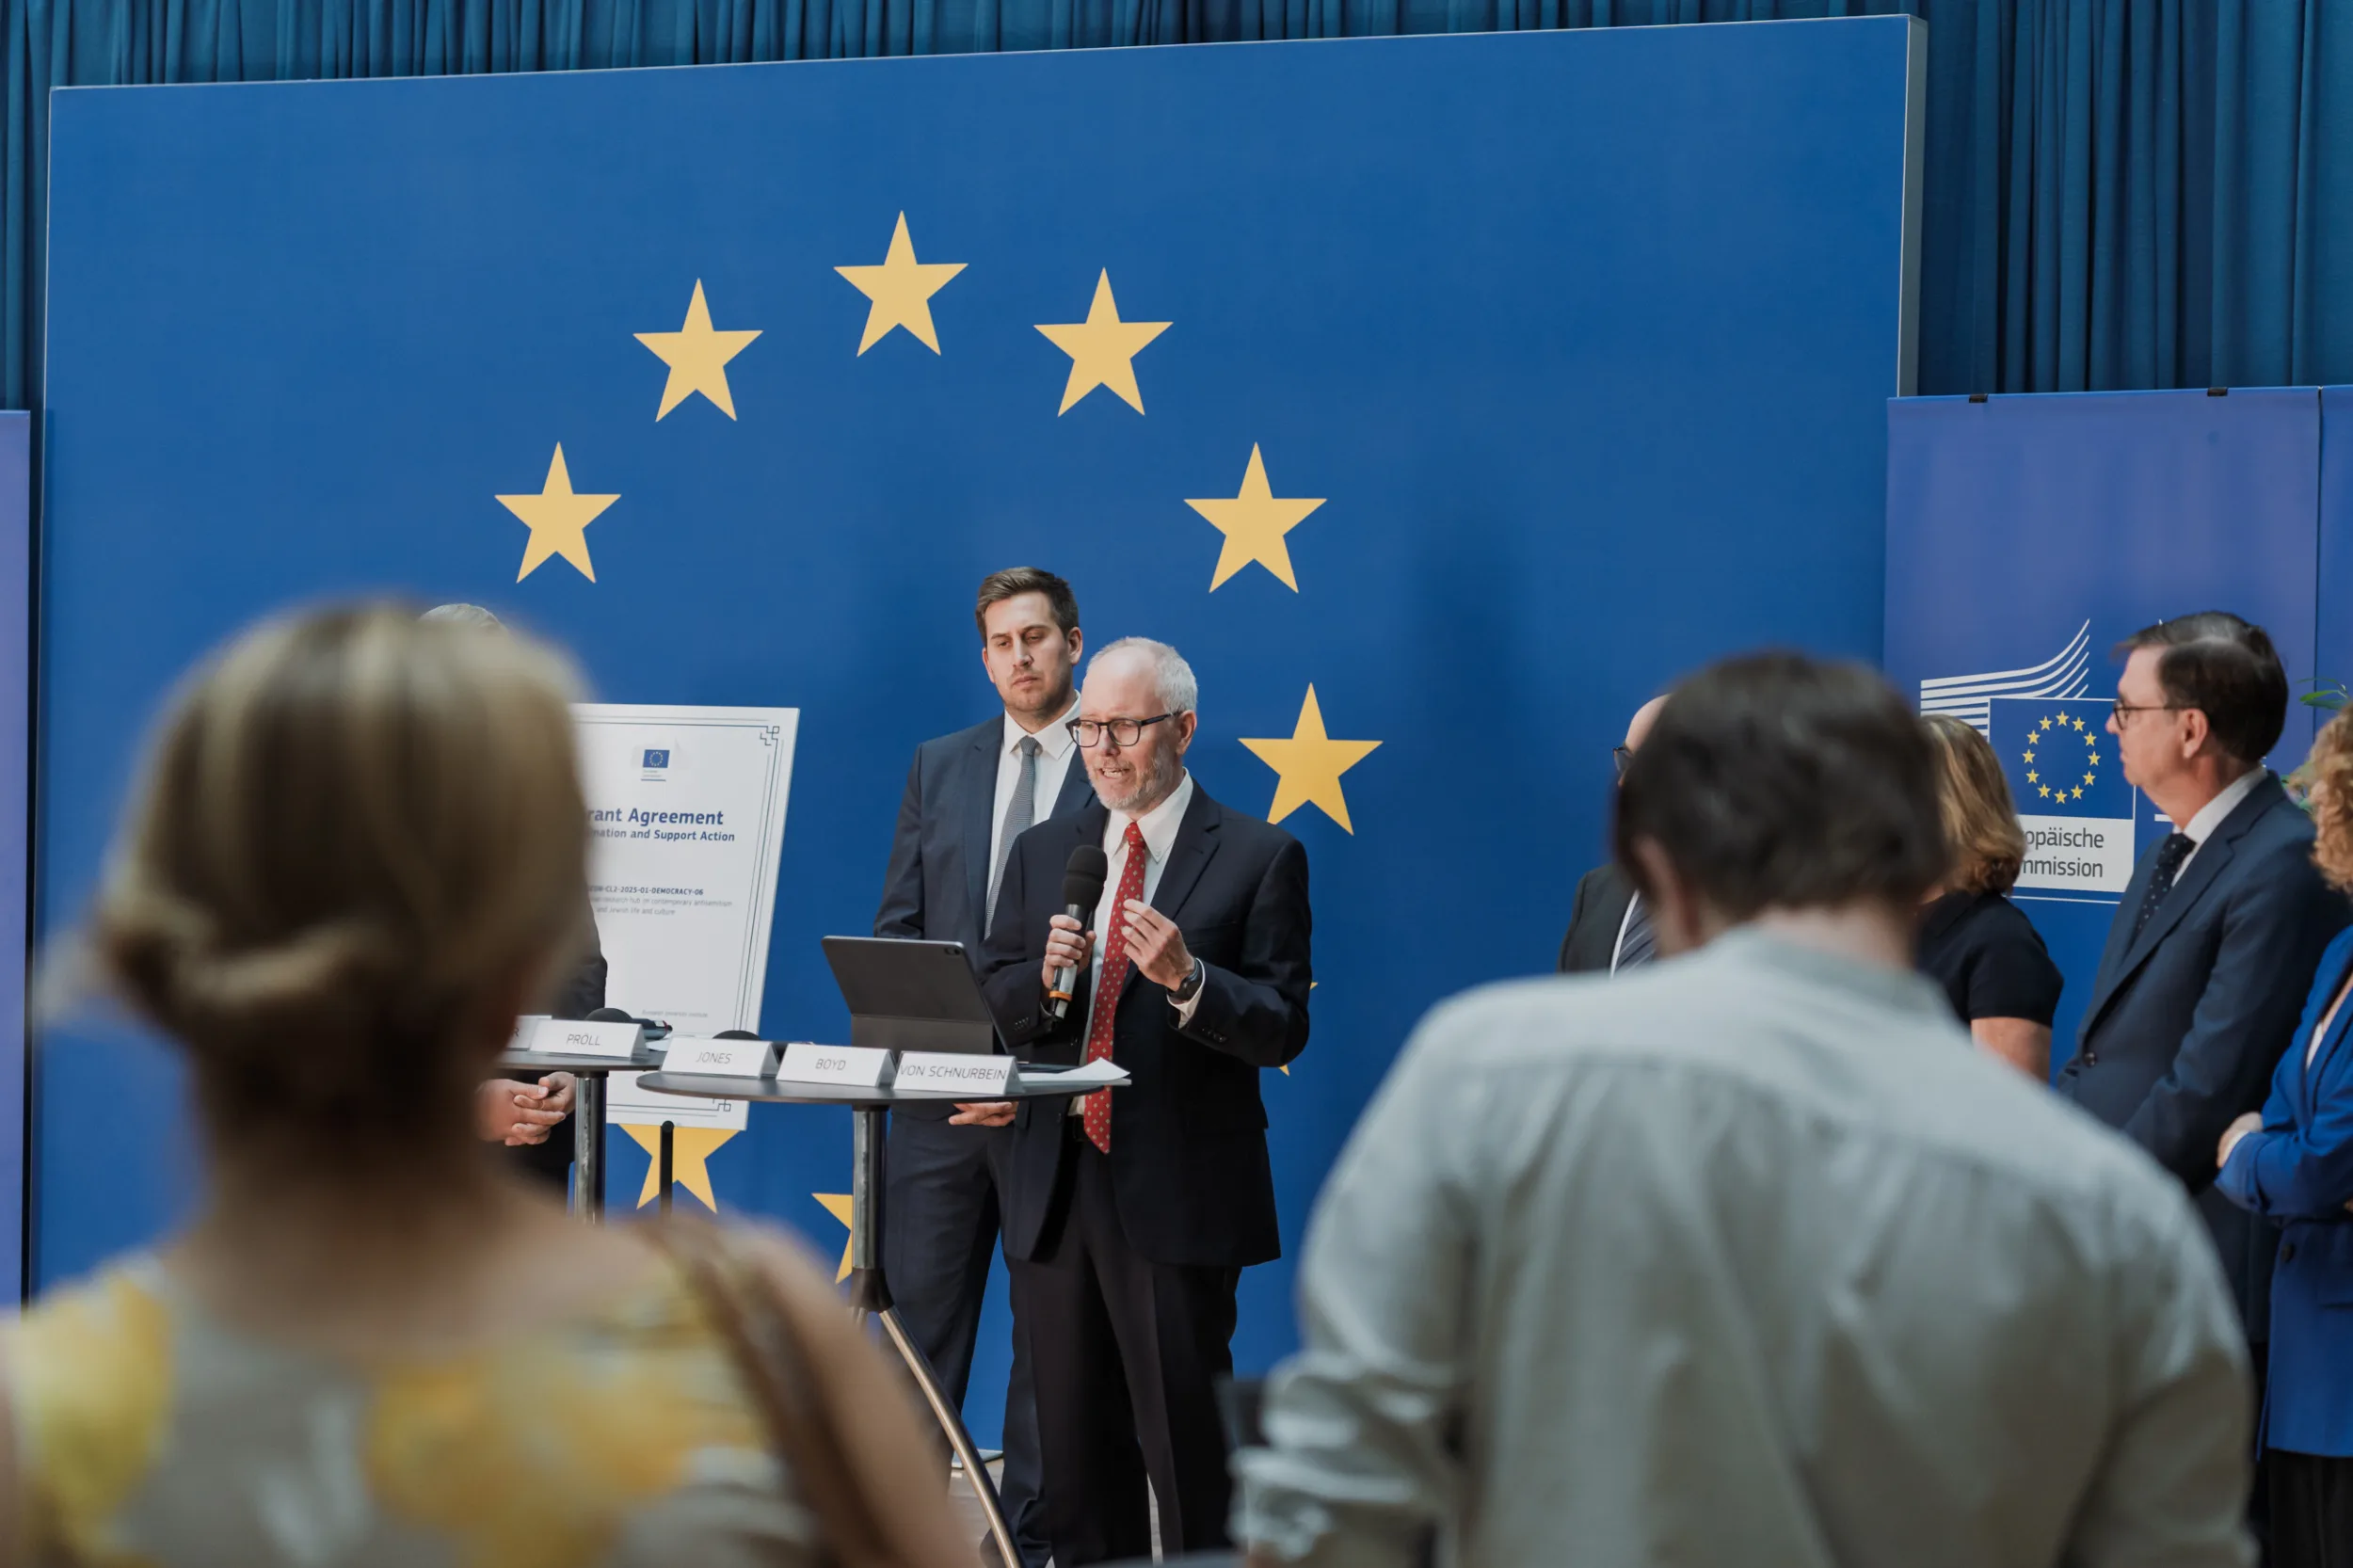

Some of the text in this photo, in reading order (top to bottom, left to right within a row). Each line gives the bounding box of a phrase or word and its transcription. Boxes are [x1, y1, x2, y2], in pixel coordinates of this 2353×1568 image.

[586, 808, 724, 826] rant Agreement
[592, 828, 735, 841] nation and Support Action
[2025, 827, 2105, 850] opäische
[695, 1051, 731, 1064] JONES
[815, 1059, 846, 1071] BOYD
[901, 1064, 926, 1076] VON
